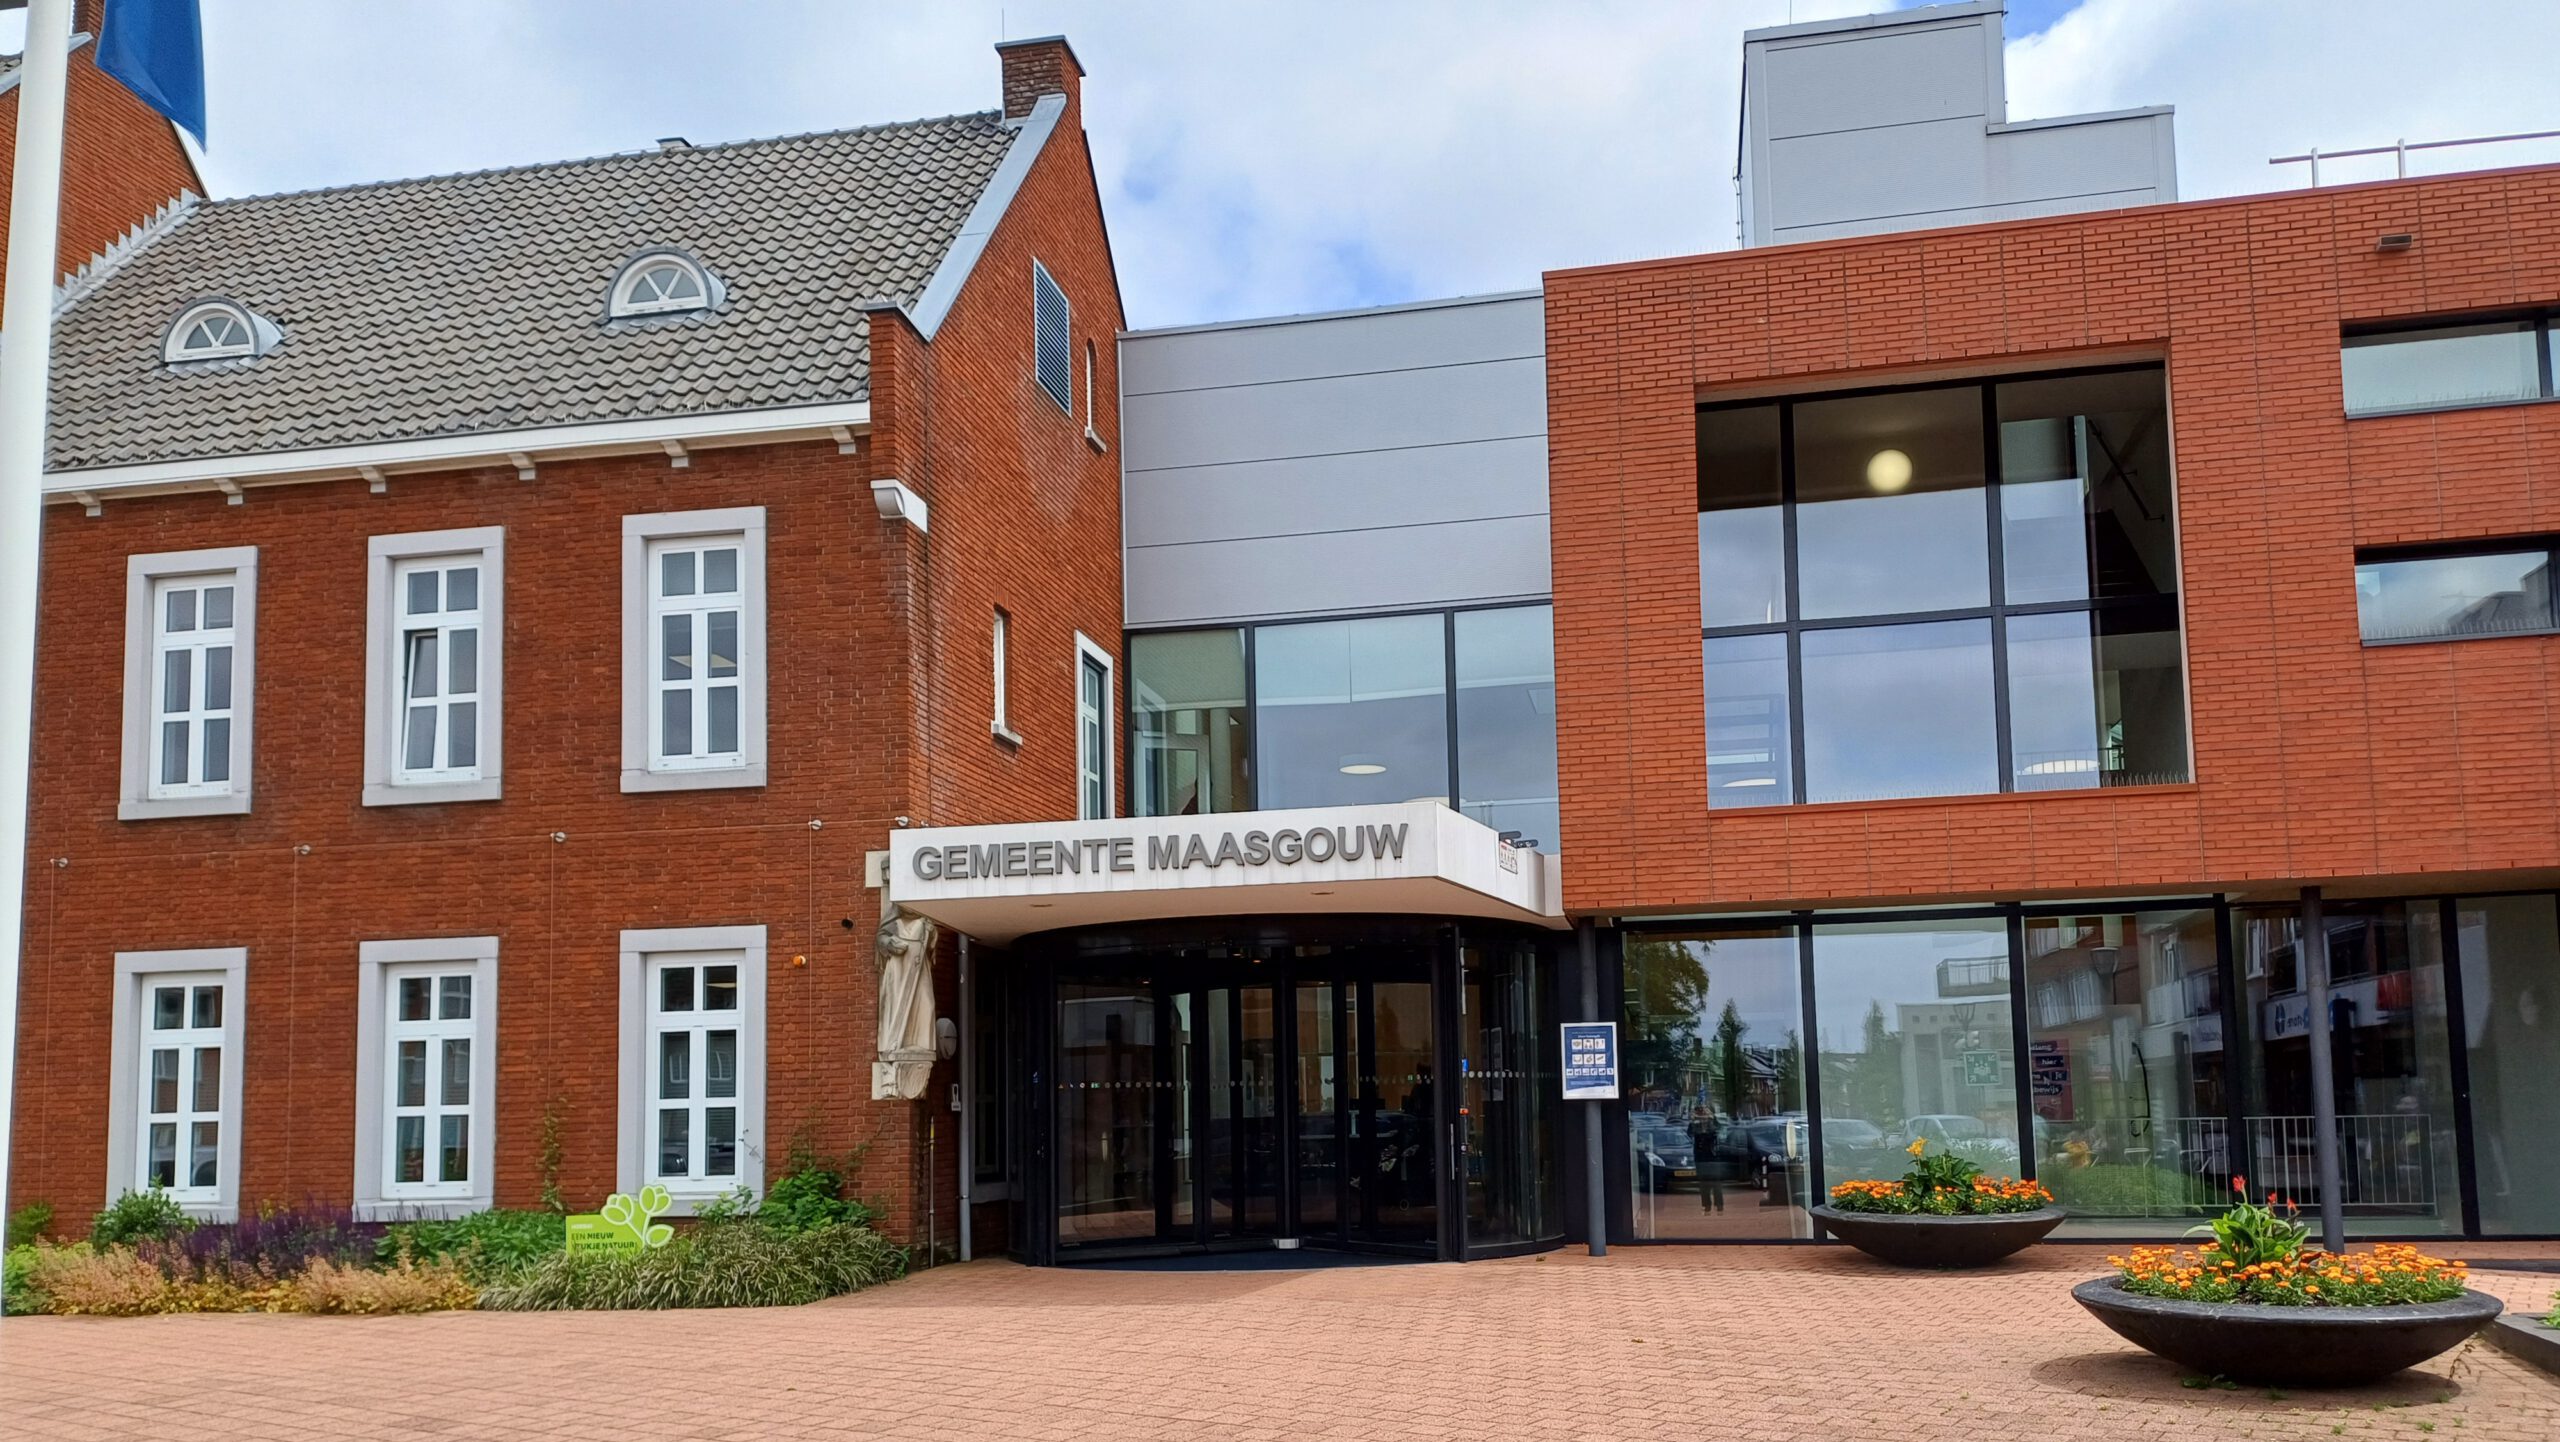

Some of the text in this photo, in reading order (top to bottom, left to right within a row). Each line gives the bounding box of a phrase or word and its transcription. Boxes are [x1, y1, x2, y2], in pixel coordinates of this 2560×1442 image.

[912, 823, 1409, 881] GEMEENTE MAASGOUW
[587, 1232, 614, 1240] NIEUW
[571, 1242, 601, 1250] TUKJE
